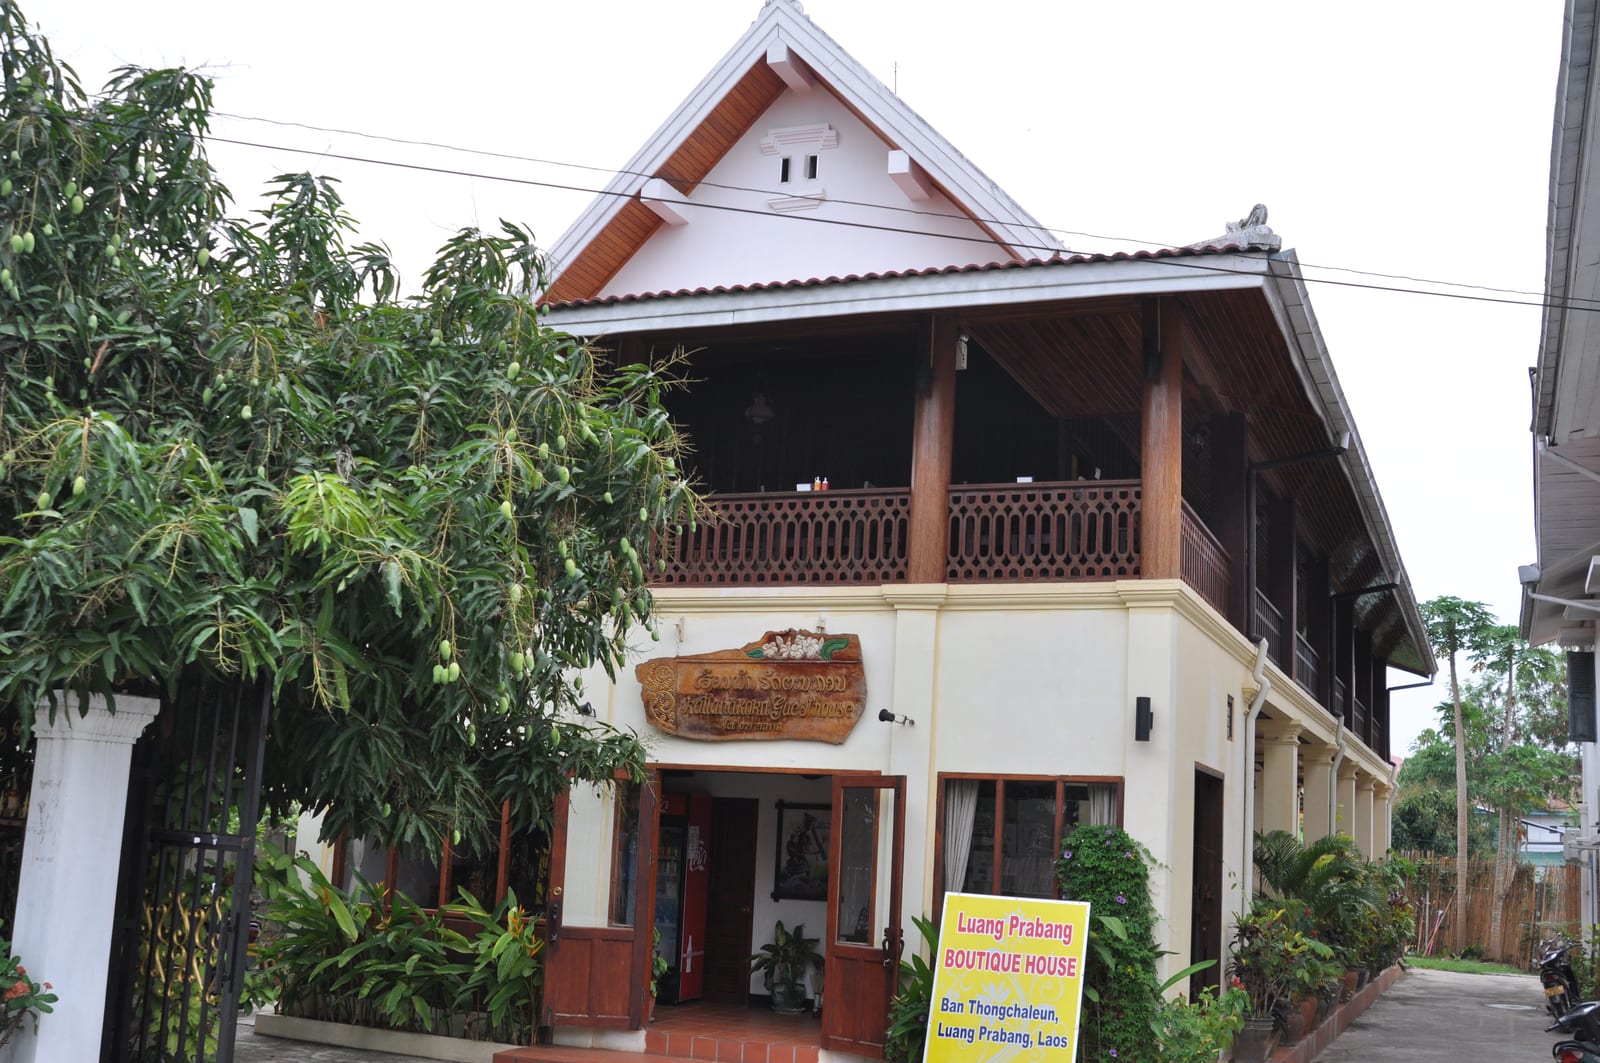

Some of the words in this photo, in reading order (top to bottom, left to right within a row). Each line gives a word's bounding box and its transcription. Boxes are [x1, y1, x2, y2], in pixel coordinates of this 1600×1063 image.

[957, 912, 1004, 940] Luang
[1008, 915, 1073, 945] Prabang
[944, 949, 1022, 973] BOUTIQUE
[1025, 955, 1077, 977] HOUSE
[941, 997, 964, 1013] Ban
[968, 1000, 1059, 1024] Thongchaleun,
[937, 1022, 975, 1043] Luang
[978, 1026, 1033, 1049] Prabang,
[1037, 1031, 1068, 1047] Laos
